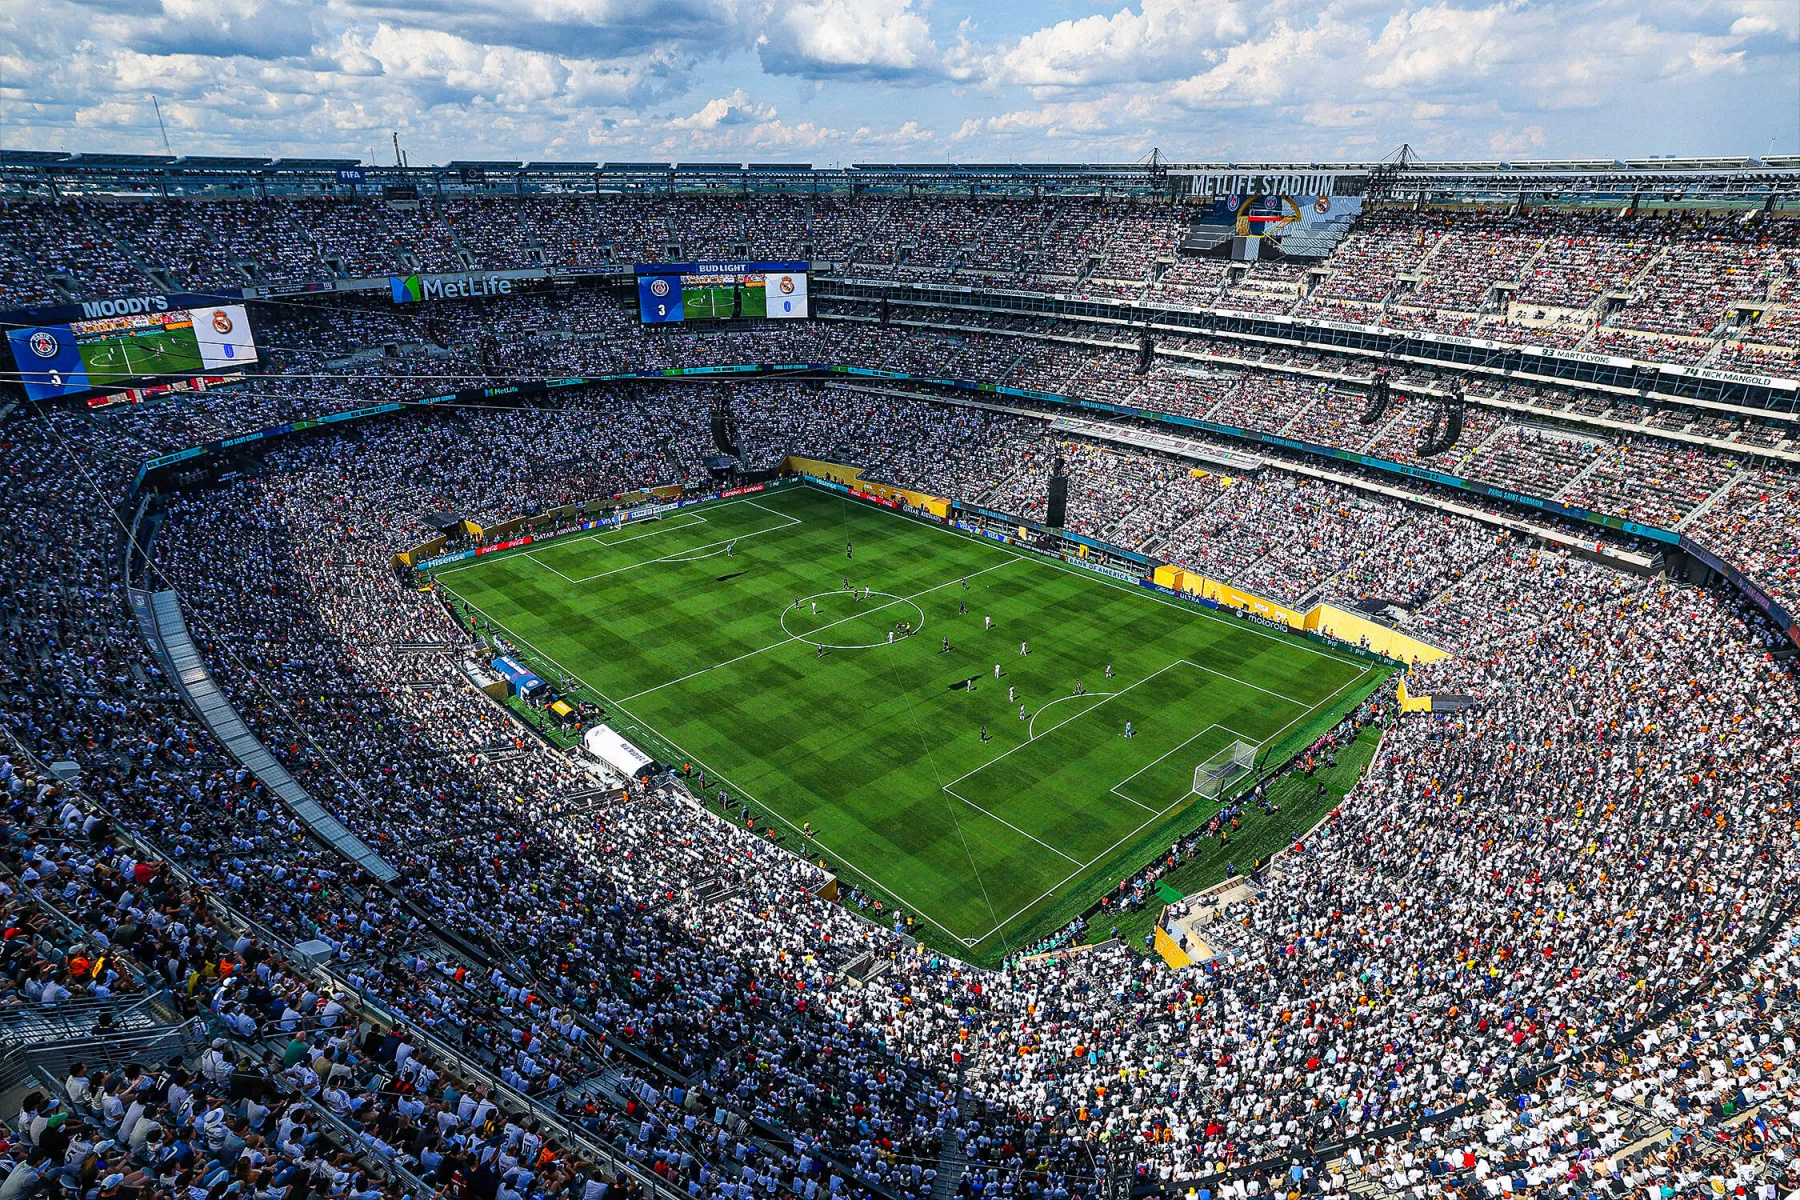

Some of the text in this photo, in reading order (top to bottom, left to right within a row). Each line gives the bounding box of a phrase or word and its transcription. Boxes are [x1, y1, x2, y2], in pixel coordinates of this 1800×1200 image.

[1192, 176, 1335, 196] METLIFE STADIUM
[720, 264, 746, 272] LIGHT
[422, 274, 512, 299] MetLife
[82, 296, 168, 318] MOODY'S
[658, 304, 666, 316] 3
[784, 301, 791, 312] 0
[1542, 348, 1610, 364] 93 MARTY LYONS
[1683, 366, 1771, 386] 74 NICK MANGOLD
[495, 386, 518, 395] MetLife
[722, 490, 741, 498] Lenovo
[534, 524, 582, 542] QATAR AIRWAYS
[987, 531, 999, 540] VISA
[428, 552, 466, 568] Hisense
[1070, 558, 1087, 568] BANK
[1098, 567, 1128, 580] AMERICA
[1180, 593, 1200, 603] ULTRA
[1254, 602, 1268, 613] VISA
[1248, 615, 1288, 632] motorola
[156, 1075, 167, 1091] 17
[65, 1150, 77, 1164] 5
